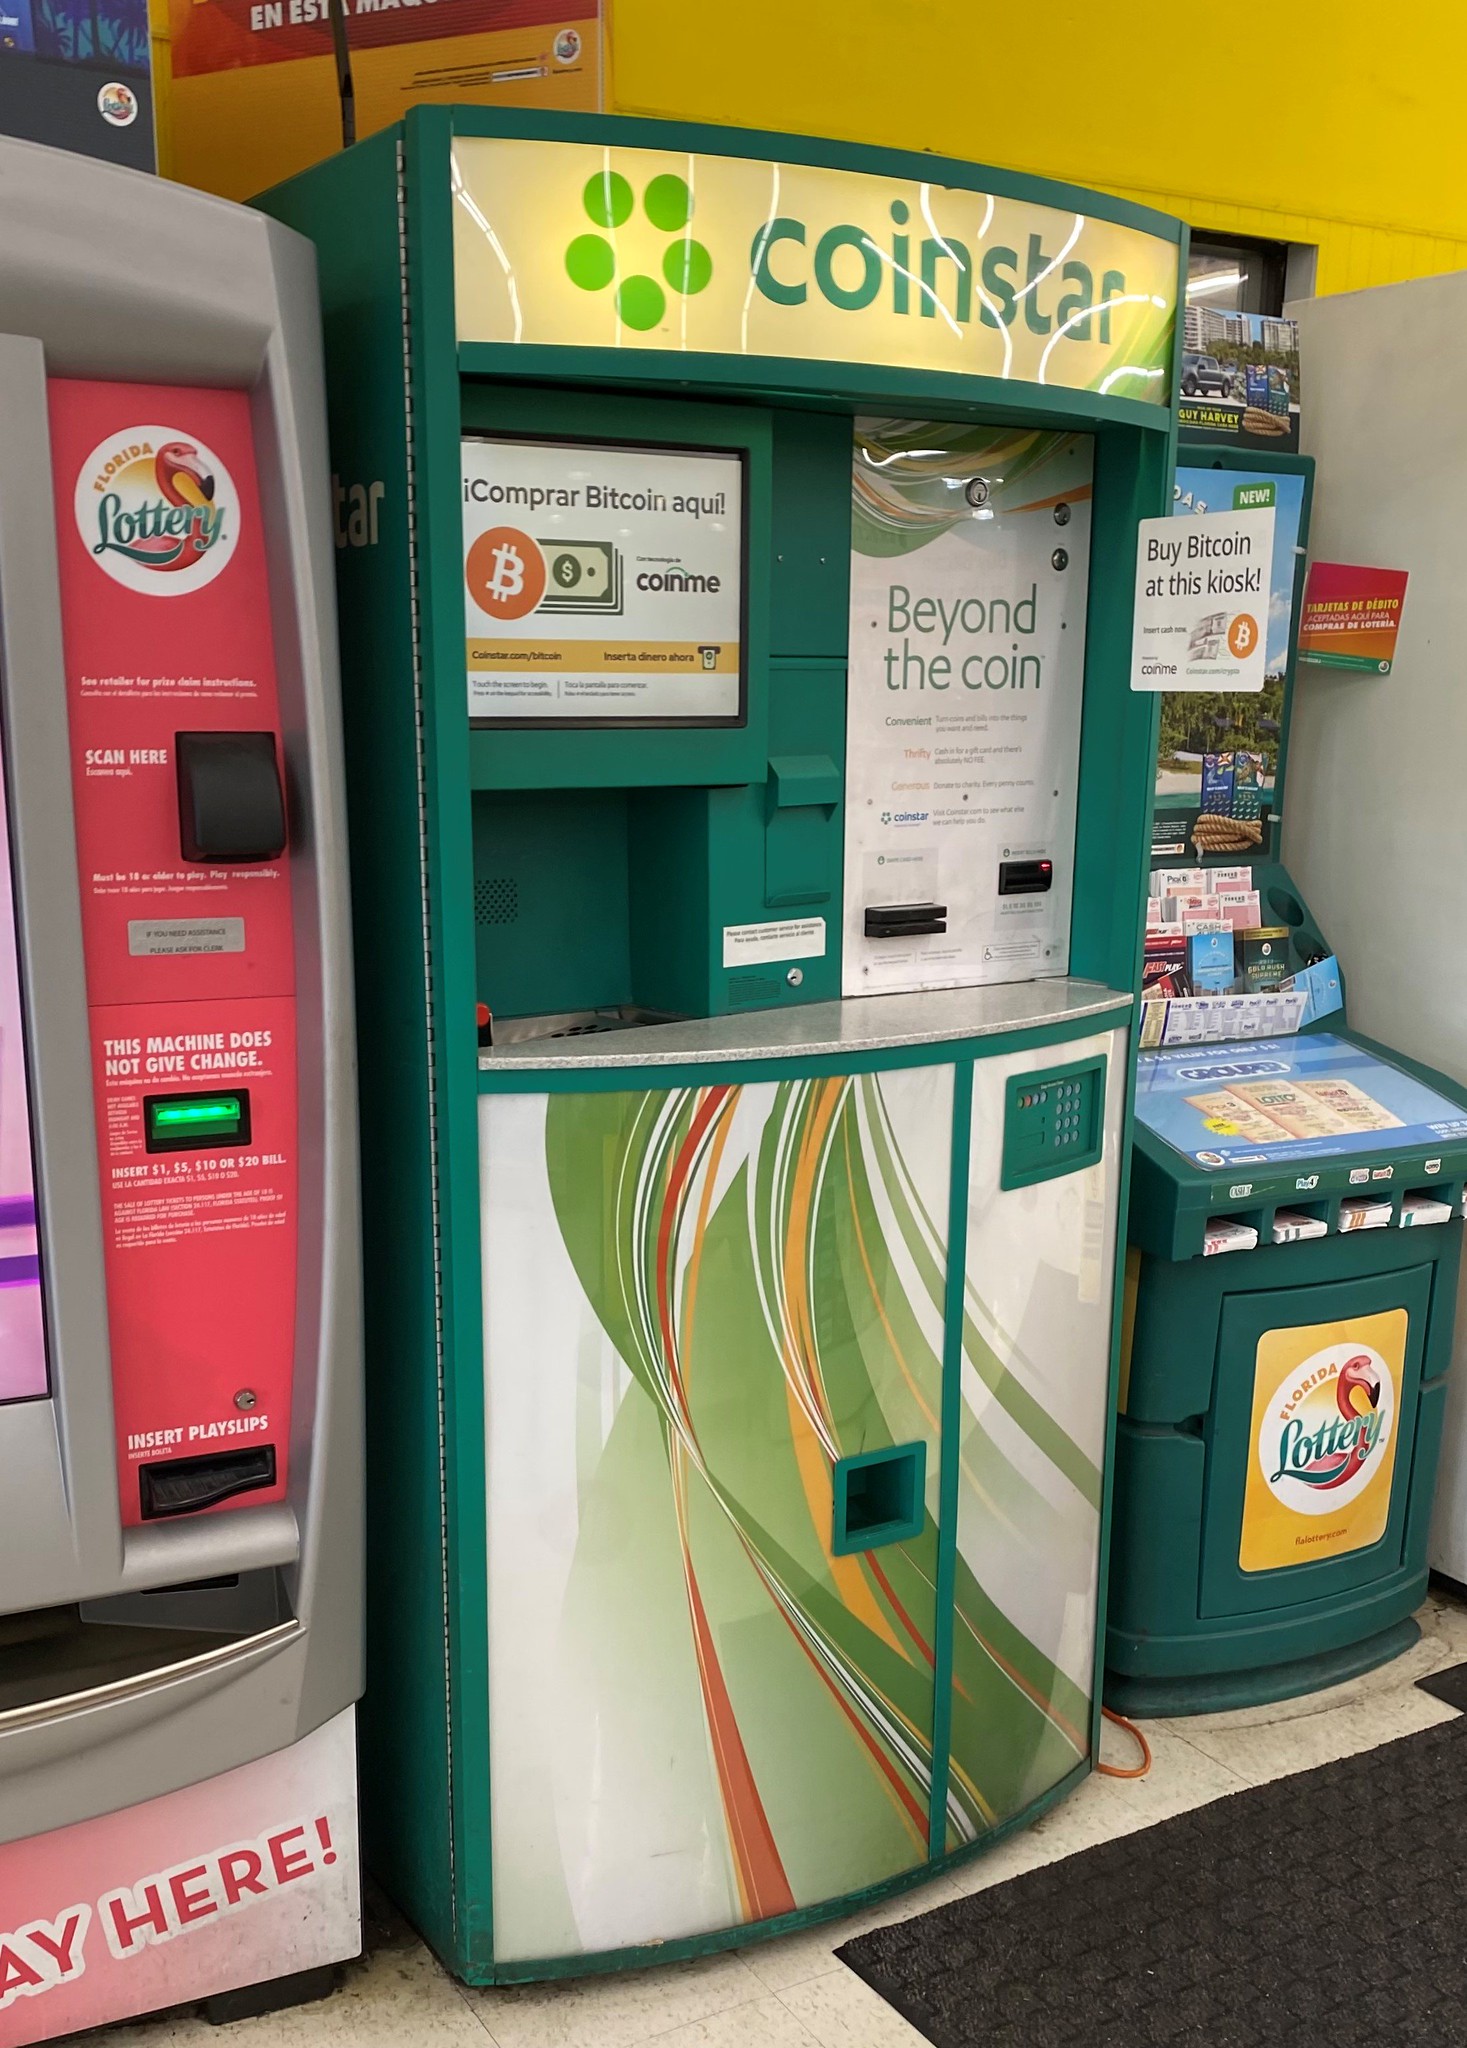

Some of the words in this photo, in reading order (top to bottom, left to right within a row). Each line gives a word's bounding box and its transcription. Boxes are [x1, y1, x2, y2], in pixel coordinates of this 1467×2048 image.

[251, 2, 283, 31] EN
[751, 198, 1126, 345] coinstar
[1179, 409, 1198, 420] GUY
[1200, 411, 1239, 424] HARVEY
[93, 442, 154, 493] FLORIDA
[586, 485, 667, 512] Bitcoin
[672, 492, 725, 519] aquí!
[1239, 488, 1270, 505] NEW!
[93, 493, 225, 562] Lottery
[1147, 538, 1182, 567] Buy
[1187, 531, 1251, 560] Bitcoin
[636, 572, 721, 593] coinme
[1145, 574, 1164, 597] at
[1168, 571, 1202, 596] this
[1207, 567, 1262, 594] kiosk!
[1307, 601, 1349, 614] TARJETAS
[1352, 600, 1364, 612] DE
[1367, 597, 1399, 610] DÉBITO
[888, 583, 1038, 646] Beyond
[1308, 613, 1350, 623] ACEPTADAS
[1371, 611, 1390, 620] PARA
[1143, 626, 1160, 634] Insert
[1161, 626, 1174, 634] cash
[1303, 621, 1345, 632] COMPRAS
[1347, 621, 1359, 630] DE
[472, 651, 562, 662] Coinstar.com/bitcoin
[604, 651, 637, 662] Inserta
[638, 652, 668, 662] dinero
[669, 652, 695, 663] ahora
[884, 637, 952, 690] the
[961, 643, 1042, 690] coin
[1141, 664, 1178, 676] coinme
[81, 677, 97, 686] See
[100, 676, 135, 686] retailer
[136, 676, 150, 686] for
[152, 677, 175, 689] prize
[177, 677, 201, 687] claim
[202, 677, 257, 688] instructions.
[885, 716, 932, 727] Convenient
[85, 749, 125, 765] SCAN
[129, 749, 168, 764] HERE
[903, 748, 932, 760] Thrifty
[934, 747, 949, 755] Cash
[956, 746, 965, 754] for
[963, 756, 974, 764] NO
[894, 811, 929, 822] coinstar
[92, 874, 115, 882] Must
[115, 873, 127, 881] be
[128, 872, 140, 881] 18
[152, 871, 175, 880] older
[176, 870, 186, 879] to
[186, 871, 208, 881] play.
[209, 869, 228, 880] Play
[153, 930, 168, 939] YOU
[168, 929, 187, 938] NEED
[187, 928, 227, 937] ASSISTANCE
[149, 946, 175, 955] PLEASE
[175, 946, 188, 954] ASK
[188, 945, 204, 954] FOR
[1247, 965, 1266, 975] GOLD
[1266, 962, 1286, 972] RUSH
[104, 1039, 142, 1056] THIS
[146, 1033, 225, 1053] MACHINE
[230, 1031, 272, 1049] DOES
[105, 1058, 141, 1076] NOT
[145, 1055, 186, 1073] GIVE
[190, 1051, 264, 1070] CHANGE.
[1256, 1093, 1298, 1106] LOTTO
[111, 1166, 149, 1179] INSERT
[151, 1163, 171, 1177] $1,
[173, 1161, 192, 1175] $5,
[194, 1159, 217, 1171] $10
[219, 1158, 235, 1169] OR
[237, 1156, 259, 1167] $20
[261, 1154, 287, 1166] BILL.
[1279, 1362, 1339, 1421] FLORIDA
[127, 1427, 184, 1450] INSERT
[188, 1415, 269, 1441] PLAYSLIPS
[127, 1450, 151, 1460] INSERTE
[151, 1447, 172, 1457] BOLETA
[1269, 1408, 1386, 1484] Lottery
[1294, 1527, 1348, 1546] flalottery.com
[108, 1816, 338, 1950] HERE!
